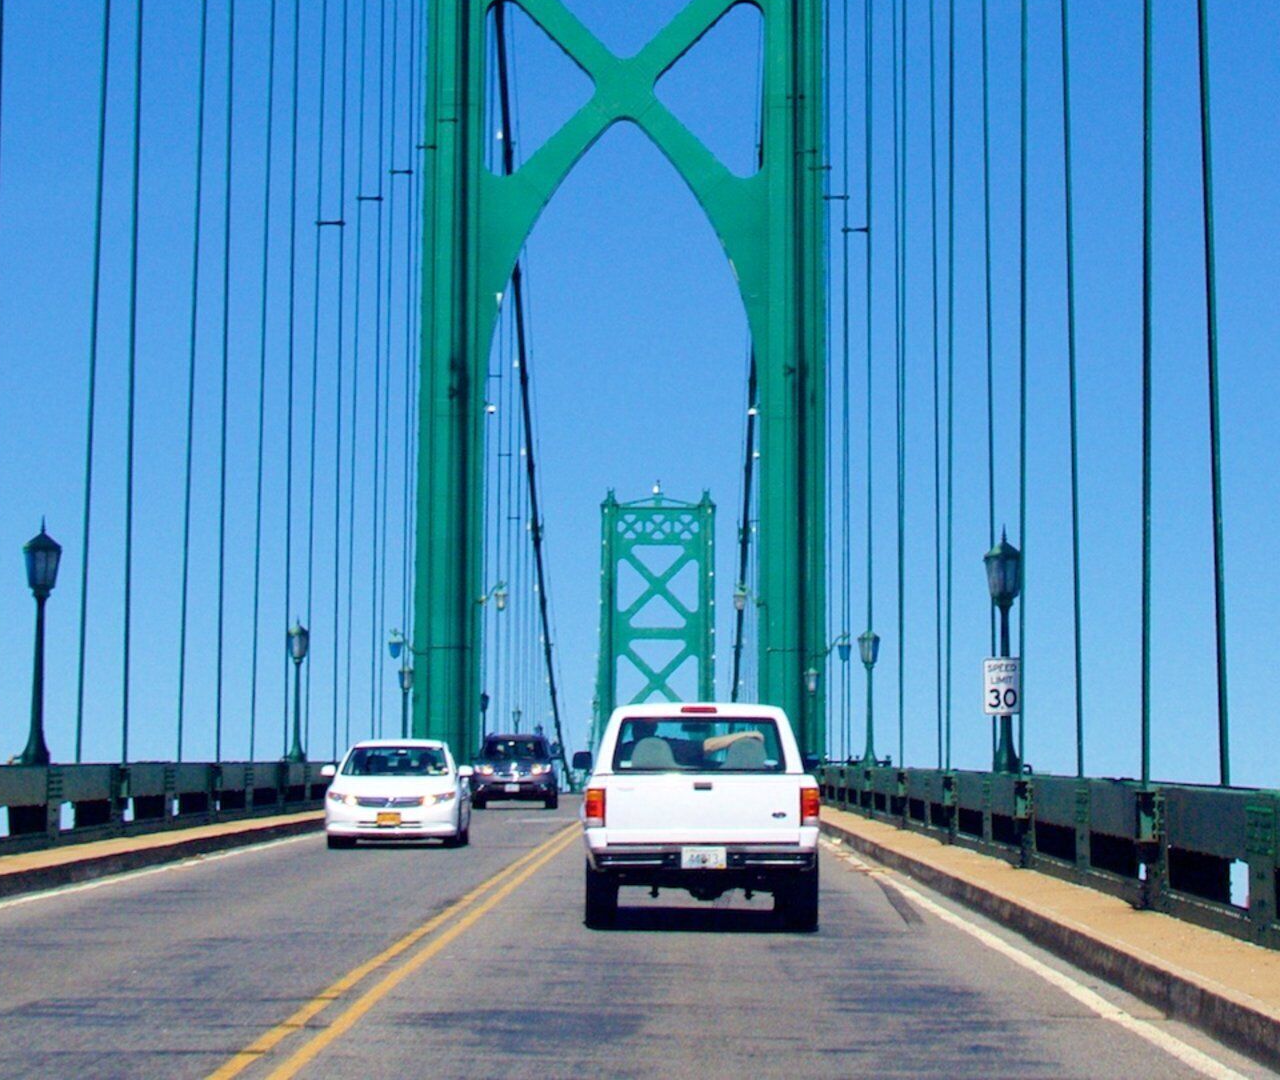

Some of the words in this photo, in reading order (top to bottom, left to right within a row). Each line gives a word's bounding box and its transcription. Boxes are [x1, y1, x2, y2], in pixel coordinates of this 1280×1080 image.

[987, 663, 1017, 673] SPEED
[990, 675, 1014, 685] LIMIT
[988, 688, 1017, 708] 30
